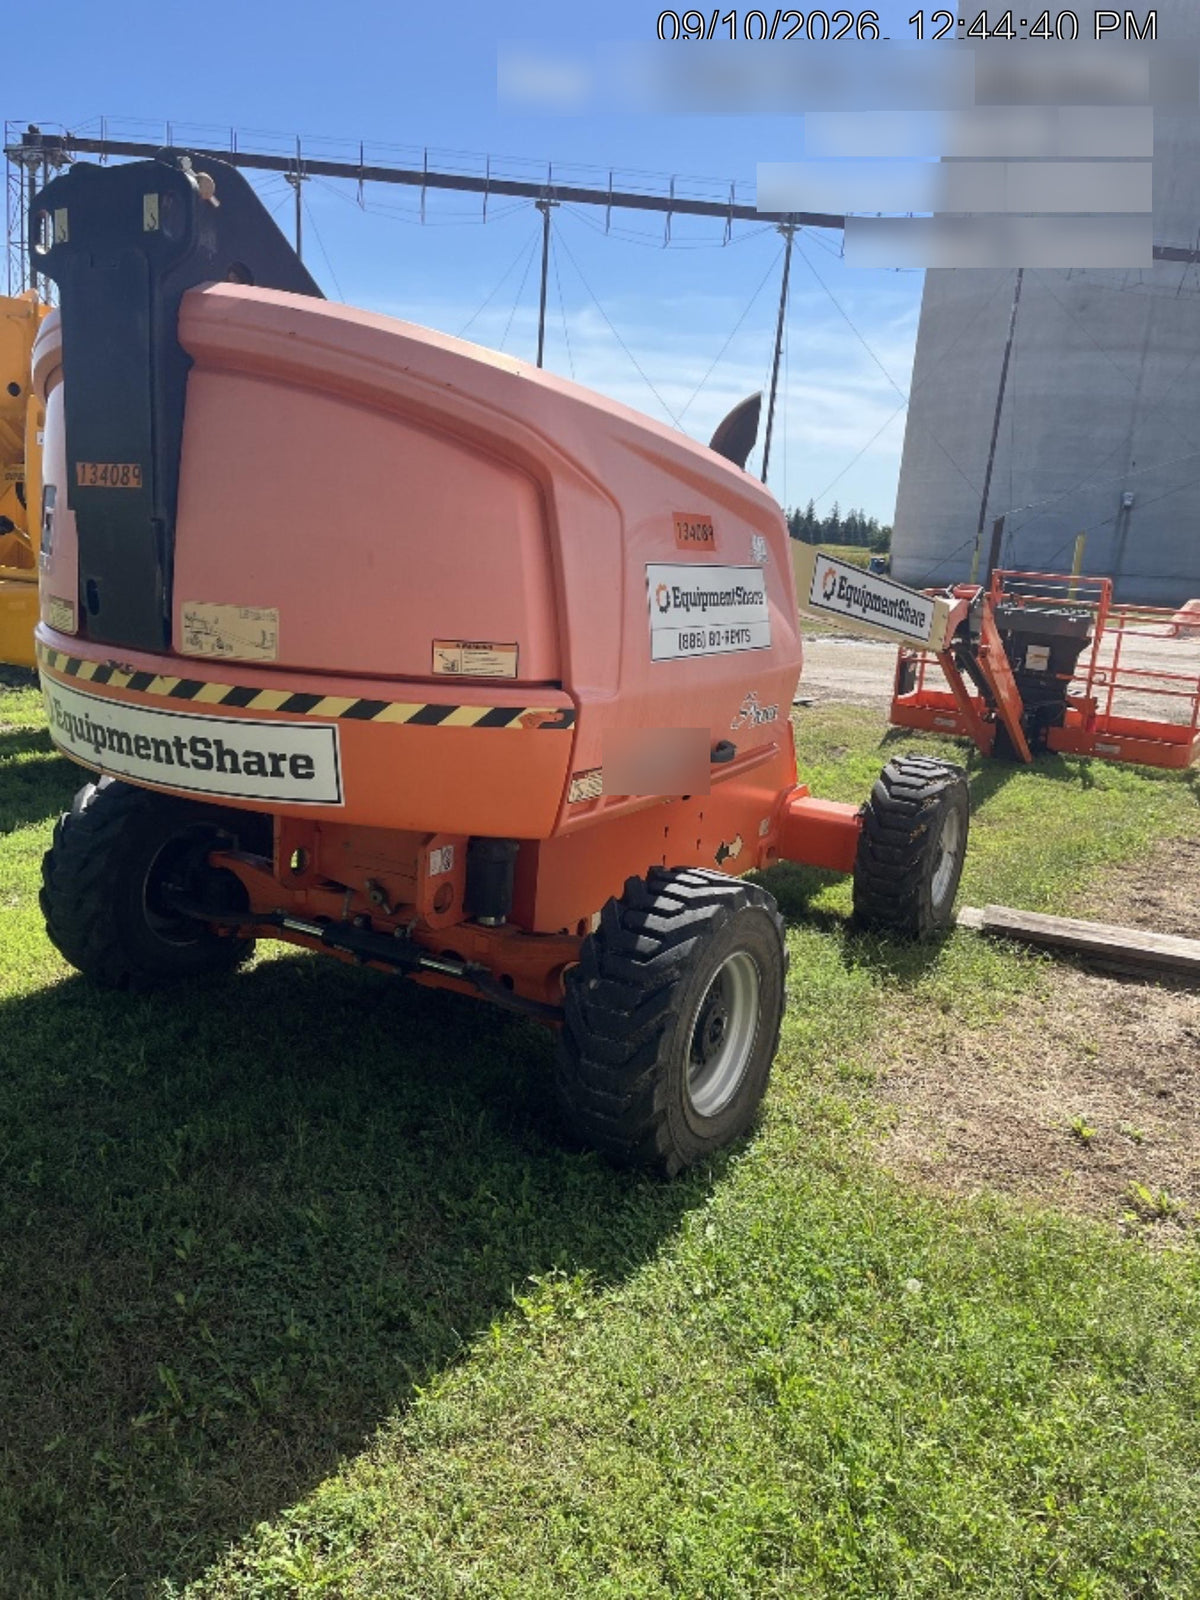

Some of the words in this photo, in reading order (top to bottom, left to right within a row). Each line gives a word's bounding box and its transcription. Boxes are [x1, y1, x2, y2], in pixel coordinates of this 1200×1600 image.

[81, 464, 141, 486] 134089
[672, 586, 763, 612] EquipmentShare
[837, 575, 926, 628] EquipmentShare
[53, 697, 315, 780] EquipmentShare
